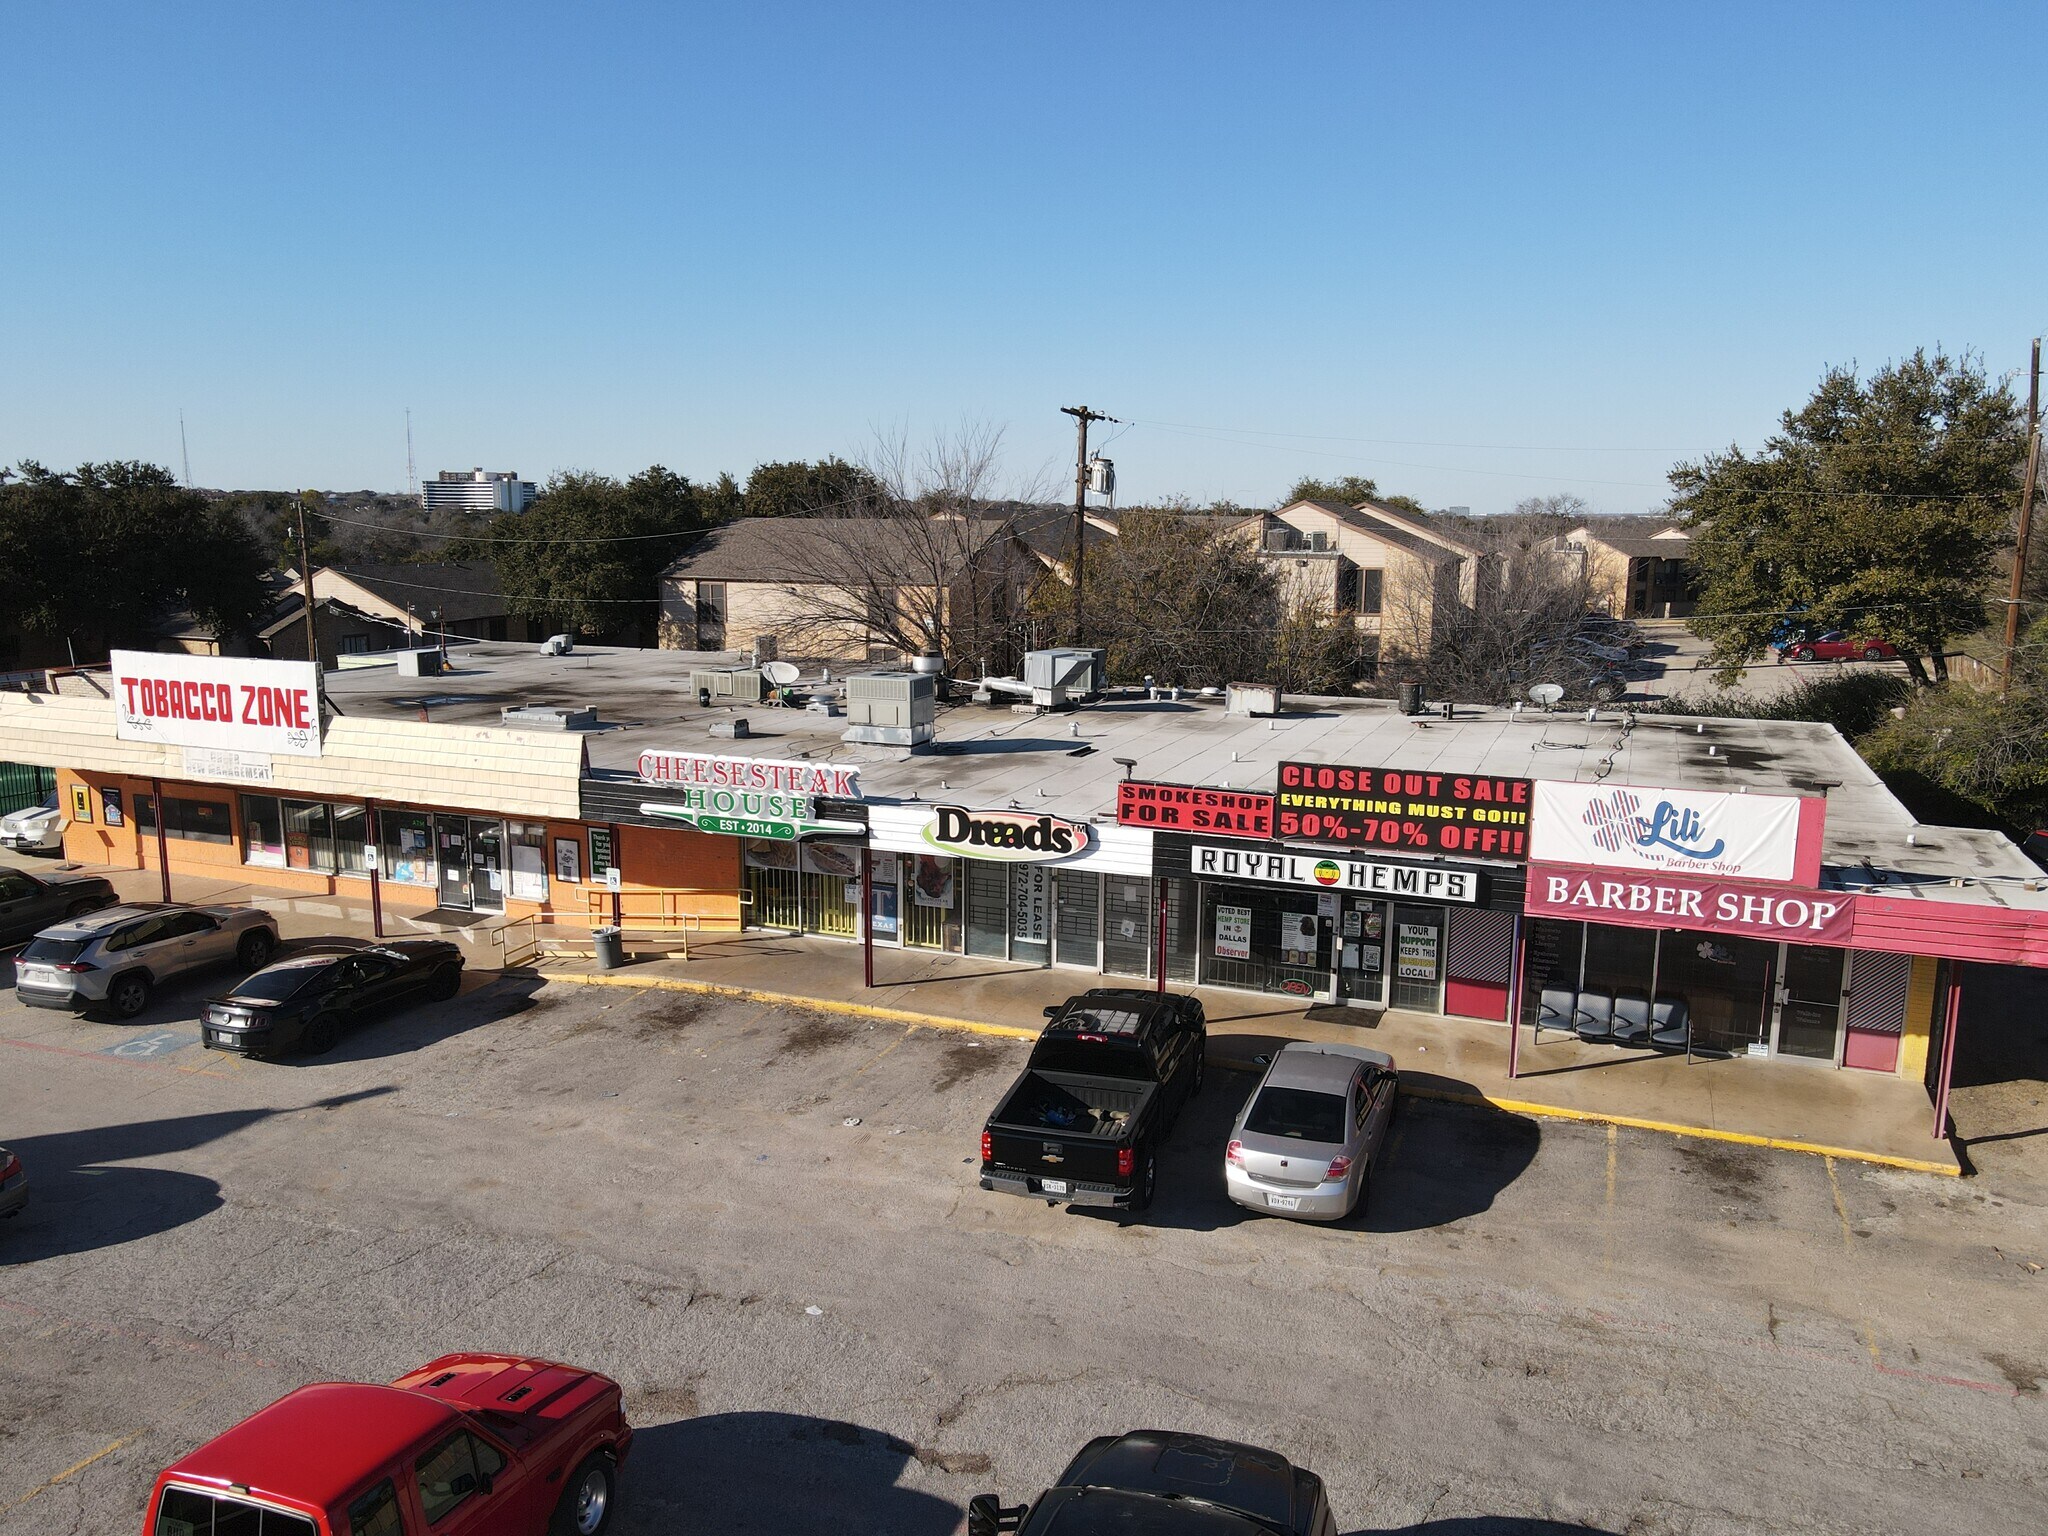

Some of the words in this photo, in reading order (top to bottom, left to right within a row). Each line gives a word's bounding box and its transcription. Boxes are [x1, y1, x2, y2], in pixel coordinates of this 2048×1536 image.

[121, 677, 233, 722] TOBACCO
[241, 685, 310, 729] ZONE
[638, 754, 853, 796] CHEESESTEAK
[1282, 765, 1372, 792] CLOSE
[1383, 773, 1443, 797] OUT
[1453, 778, 1527, 804] SALE
[684, 788, 809, 819] HOUSE
[1122, 786, 1269, 811] SMOKESHOP
[1281, 793, 1402, 815] EVERYTHING
[1408, 803, 1467, 820] MUST
[1472, 809, 1526, 825] GO!!!
[719, 822, 740, 831] EST
[746, 823, 772, 835] 2014
[935, 807, 1073, 854] Dreads
[1071, 824, 1086, 833] TM
[1121, 803, 1179, 824] FOR
[1192, 809, 1268, 833] SALE
[1637, 800, 1725, 860] Lili
[1280, 811, 1429, 846] 50%-70%
[1440, 825, 1524, 854] OFF!!
[1033, 866, 1043, 893] FOR
[1200, 850, 1306, 883] ROYAL
[1347, 863, 1467, 898] HEMPS
[1666, 857, 1709, 870] Barber
[1710, 861, 1742, 874] Shop
[1017, 863, 1029, 938] 972-704-5035
[1217, 906, 1236, 915] VOTED
[1237, 908, 1251, 916] BEST
[1546, 876, 1705, 918] BARBER
[1716, 893, 1836, 931] SHOP
[1033, 897, 1043, 940] LEASE
[1217, 915, 1233, 923] HEMP
[1234, 917, 1250, 926] STORE
[1407, 925, 1429, 936] YOUR
[1216, 945, 1249, 958] Observer
[1218, 933, 1247, 943] DALLAS
[1400, 935, 1436, 947] SUPPORT
[1400, 946, 1420, 956] KEEPS
[1422, 948, 1436, 958] THIS
[1281, 981, 1310, 995] OPEN
